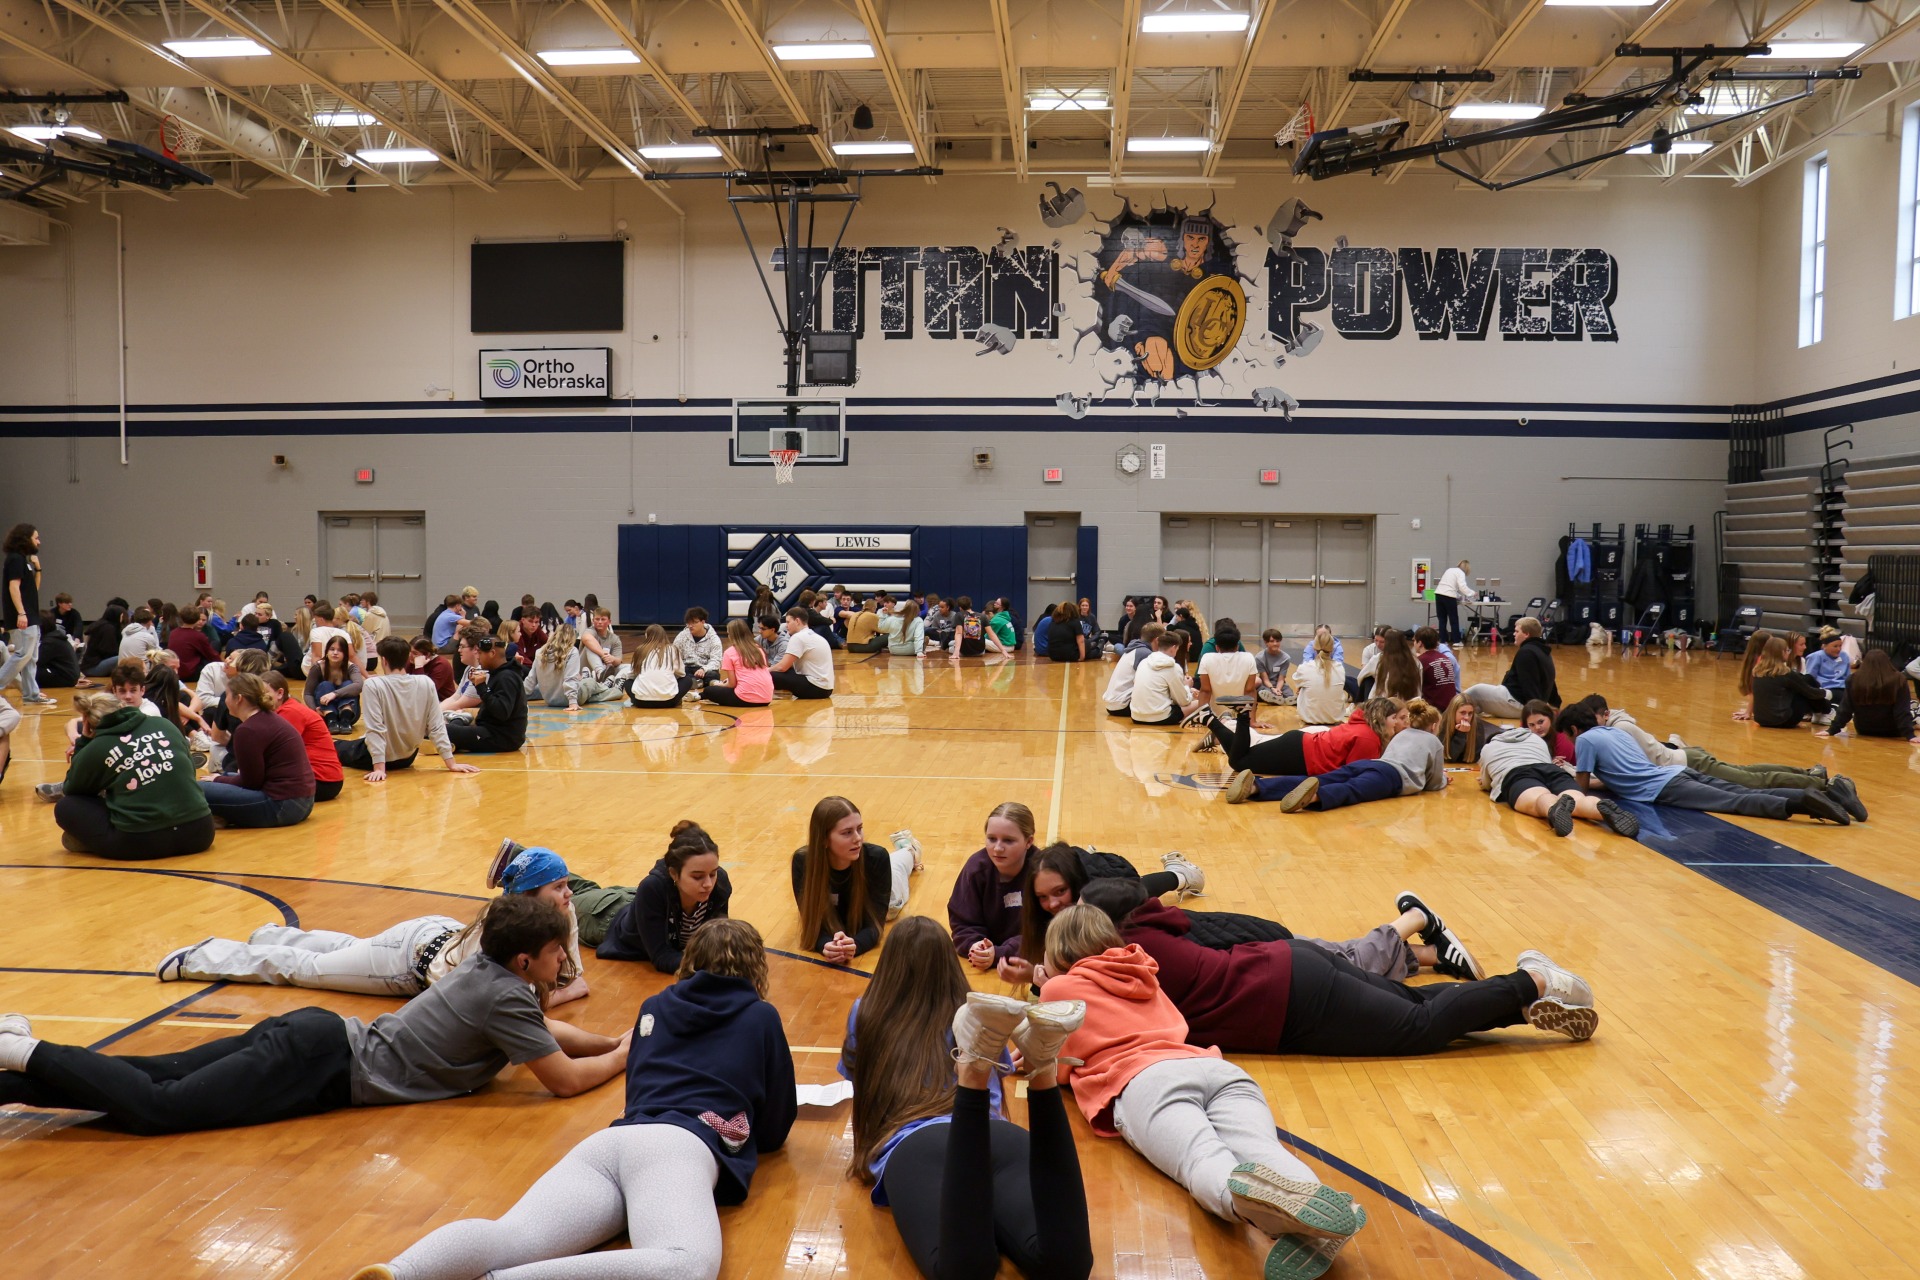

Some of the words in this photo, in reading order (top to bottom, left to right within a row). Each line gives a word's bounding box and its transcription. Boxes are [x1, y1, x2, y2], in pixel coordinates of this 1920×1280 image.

[768, 245, 1060, 340] TITAN
[1263, 246, 1619, 343] POWER
[523, 358, 575, 373] Ortho
[523, 373, 605, 389] Nebraska
[835, 536, 881, 548] LEWIS
[104, 745, 124, 768] all
[126, 730, 166, 752] you
[114, 742, 156, 774] need
[157, 748, 174, 761] is
[135, 760, 174, 782] love
